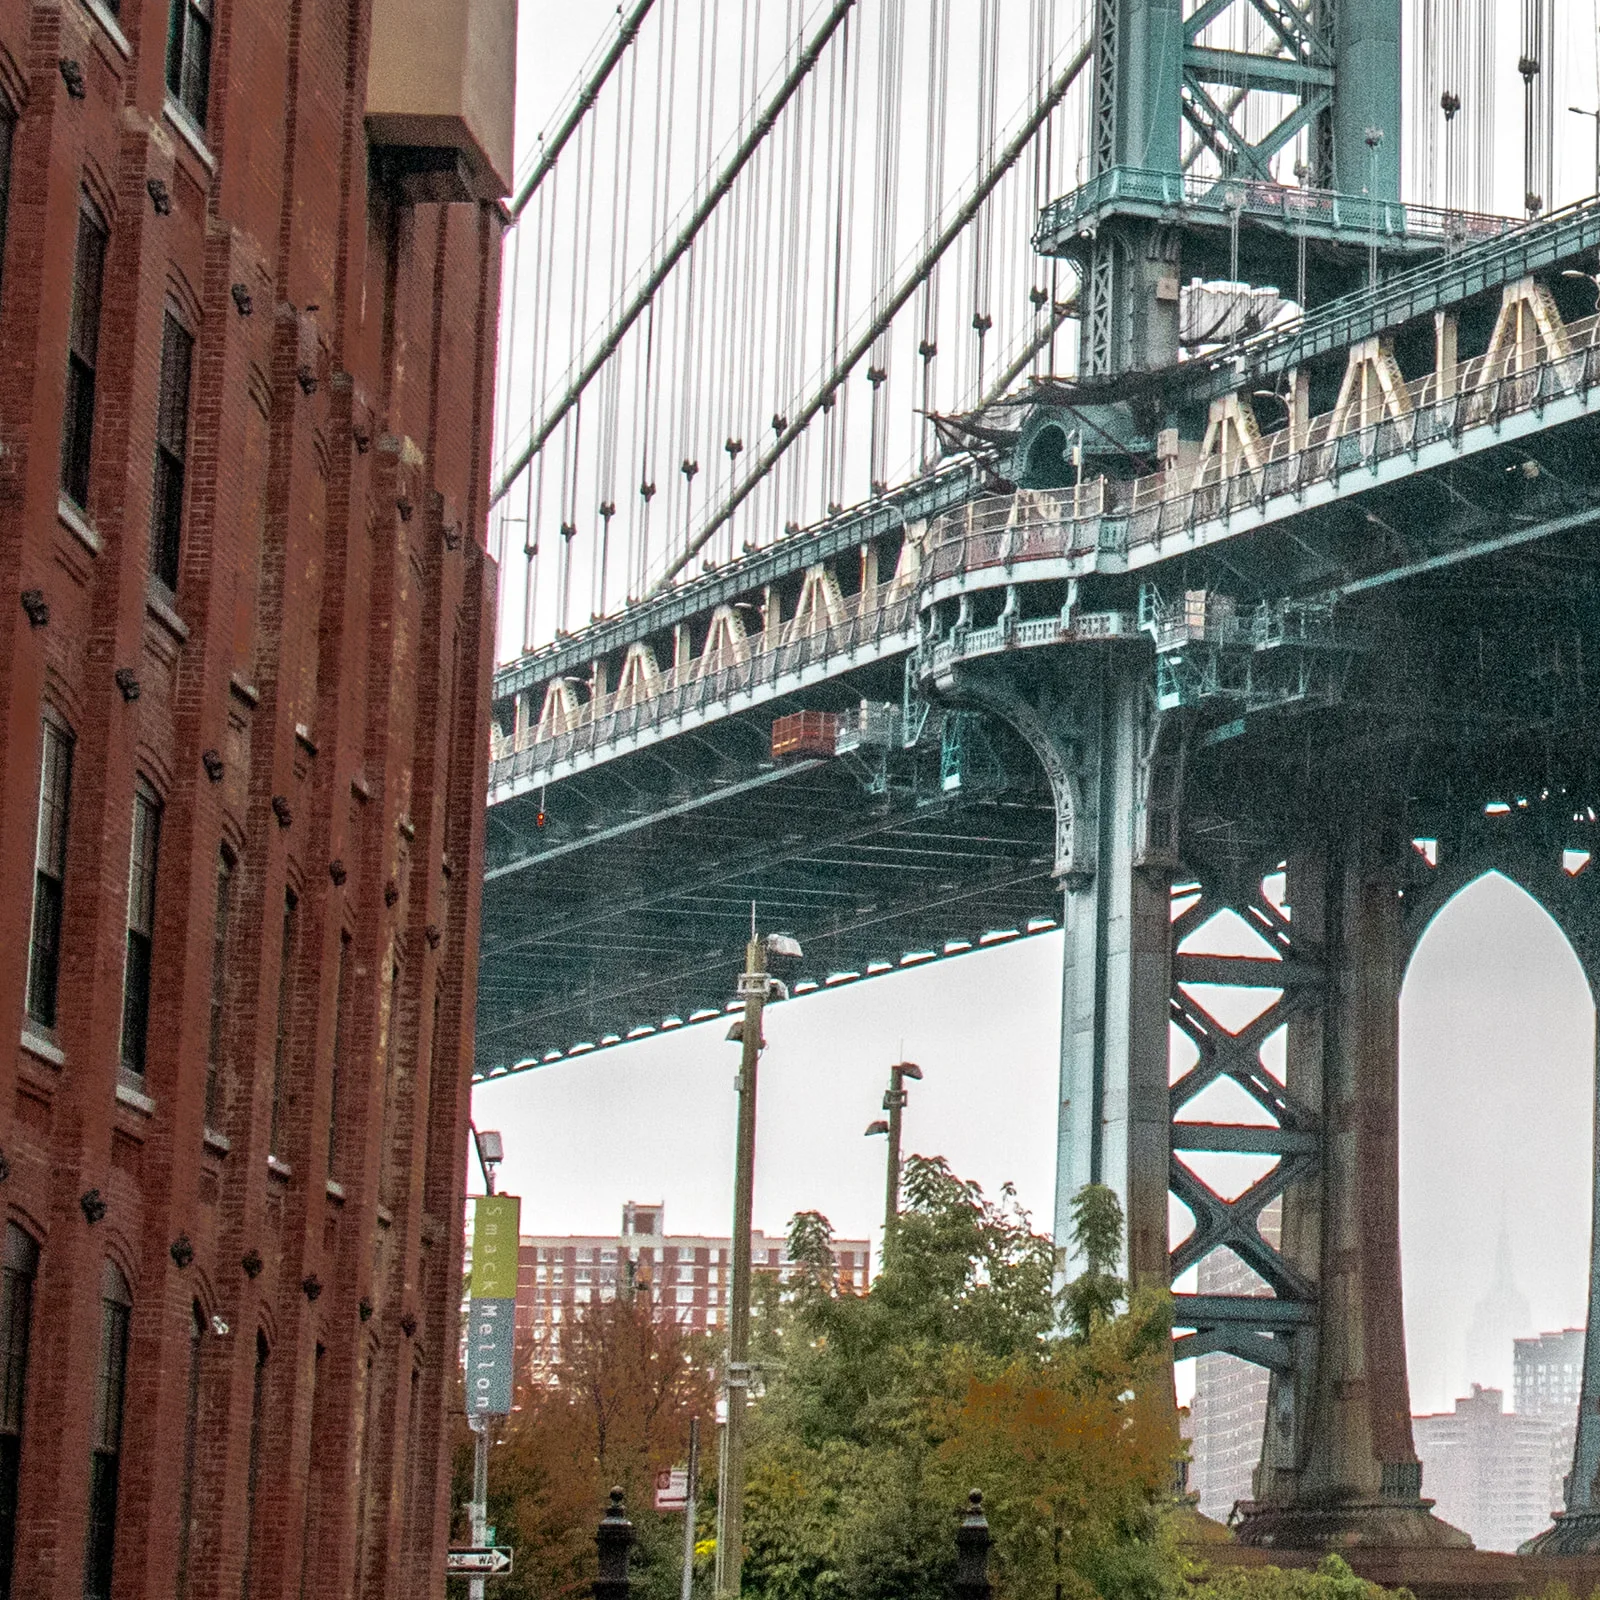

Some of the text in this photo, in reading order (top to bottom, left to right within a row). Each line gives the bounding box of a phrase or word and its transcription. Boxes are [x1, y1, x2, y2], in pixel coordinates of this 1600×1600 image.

[482, 1206, 502, 1290] Smack
[476, 1304, 498, 1408] Mellon
[478, 1554, 502, 1565] WAY
